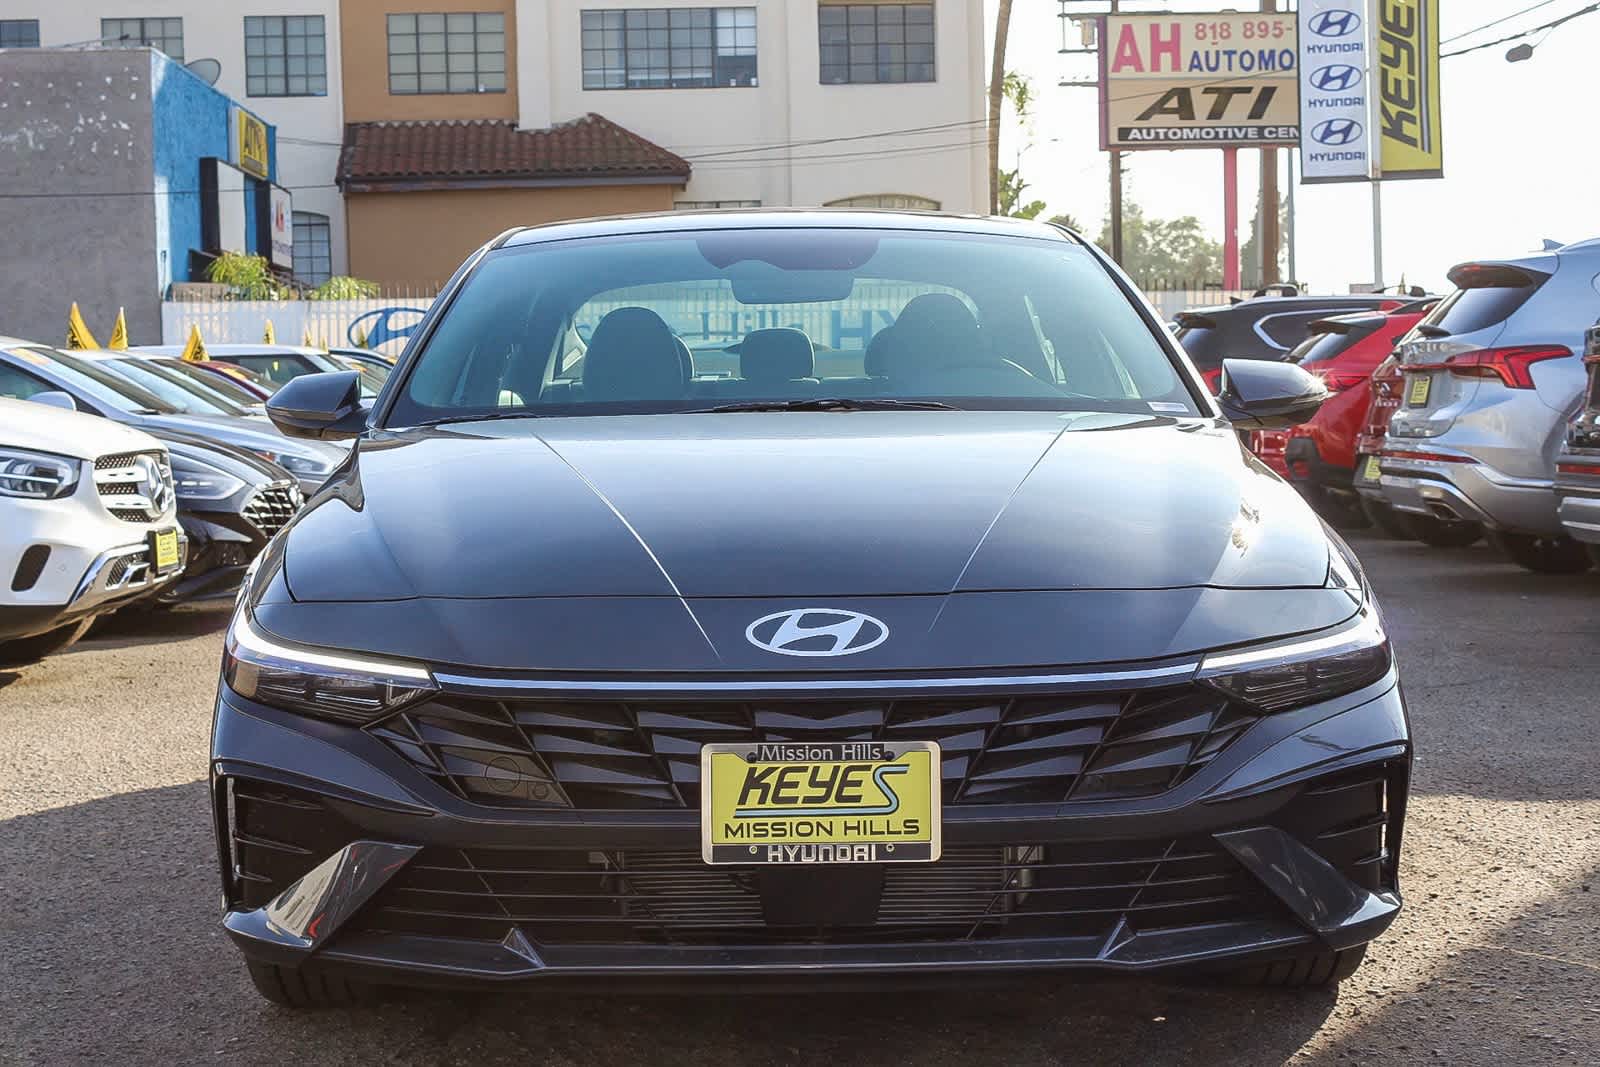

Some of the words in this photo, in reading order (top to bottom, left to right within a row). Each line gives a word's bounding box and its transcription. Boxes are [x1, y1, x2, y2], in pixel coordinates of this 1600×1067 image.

[1194, 22, 1232, 41] 818
[1111, 22, 1182, 73] AH
[1307, 42, 1364, 54] HYUNDAI
[1188, 48, 1295, 73] AUTOMO
[1134, 86, 1278, 121] ATI
[1308, 96, 1365, 108] HYUNDAI
[1128, 127, 1258, 140] AUTOMOTIVE
[1309, 151, 1366, 162] HYUNDAI
[761, 744, 833, 761] Mission
[841, 744, 881, 760] Hills
[734, 763, 910, 818] KEYES
[724, 820, 833, 839] MISSION
[843, 819, 920, 836] HILLS
[767, 844, 876, 862] HYUNDAI
